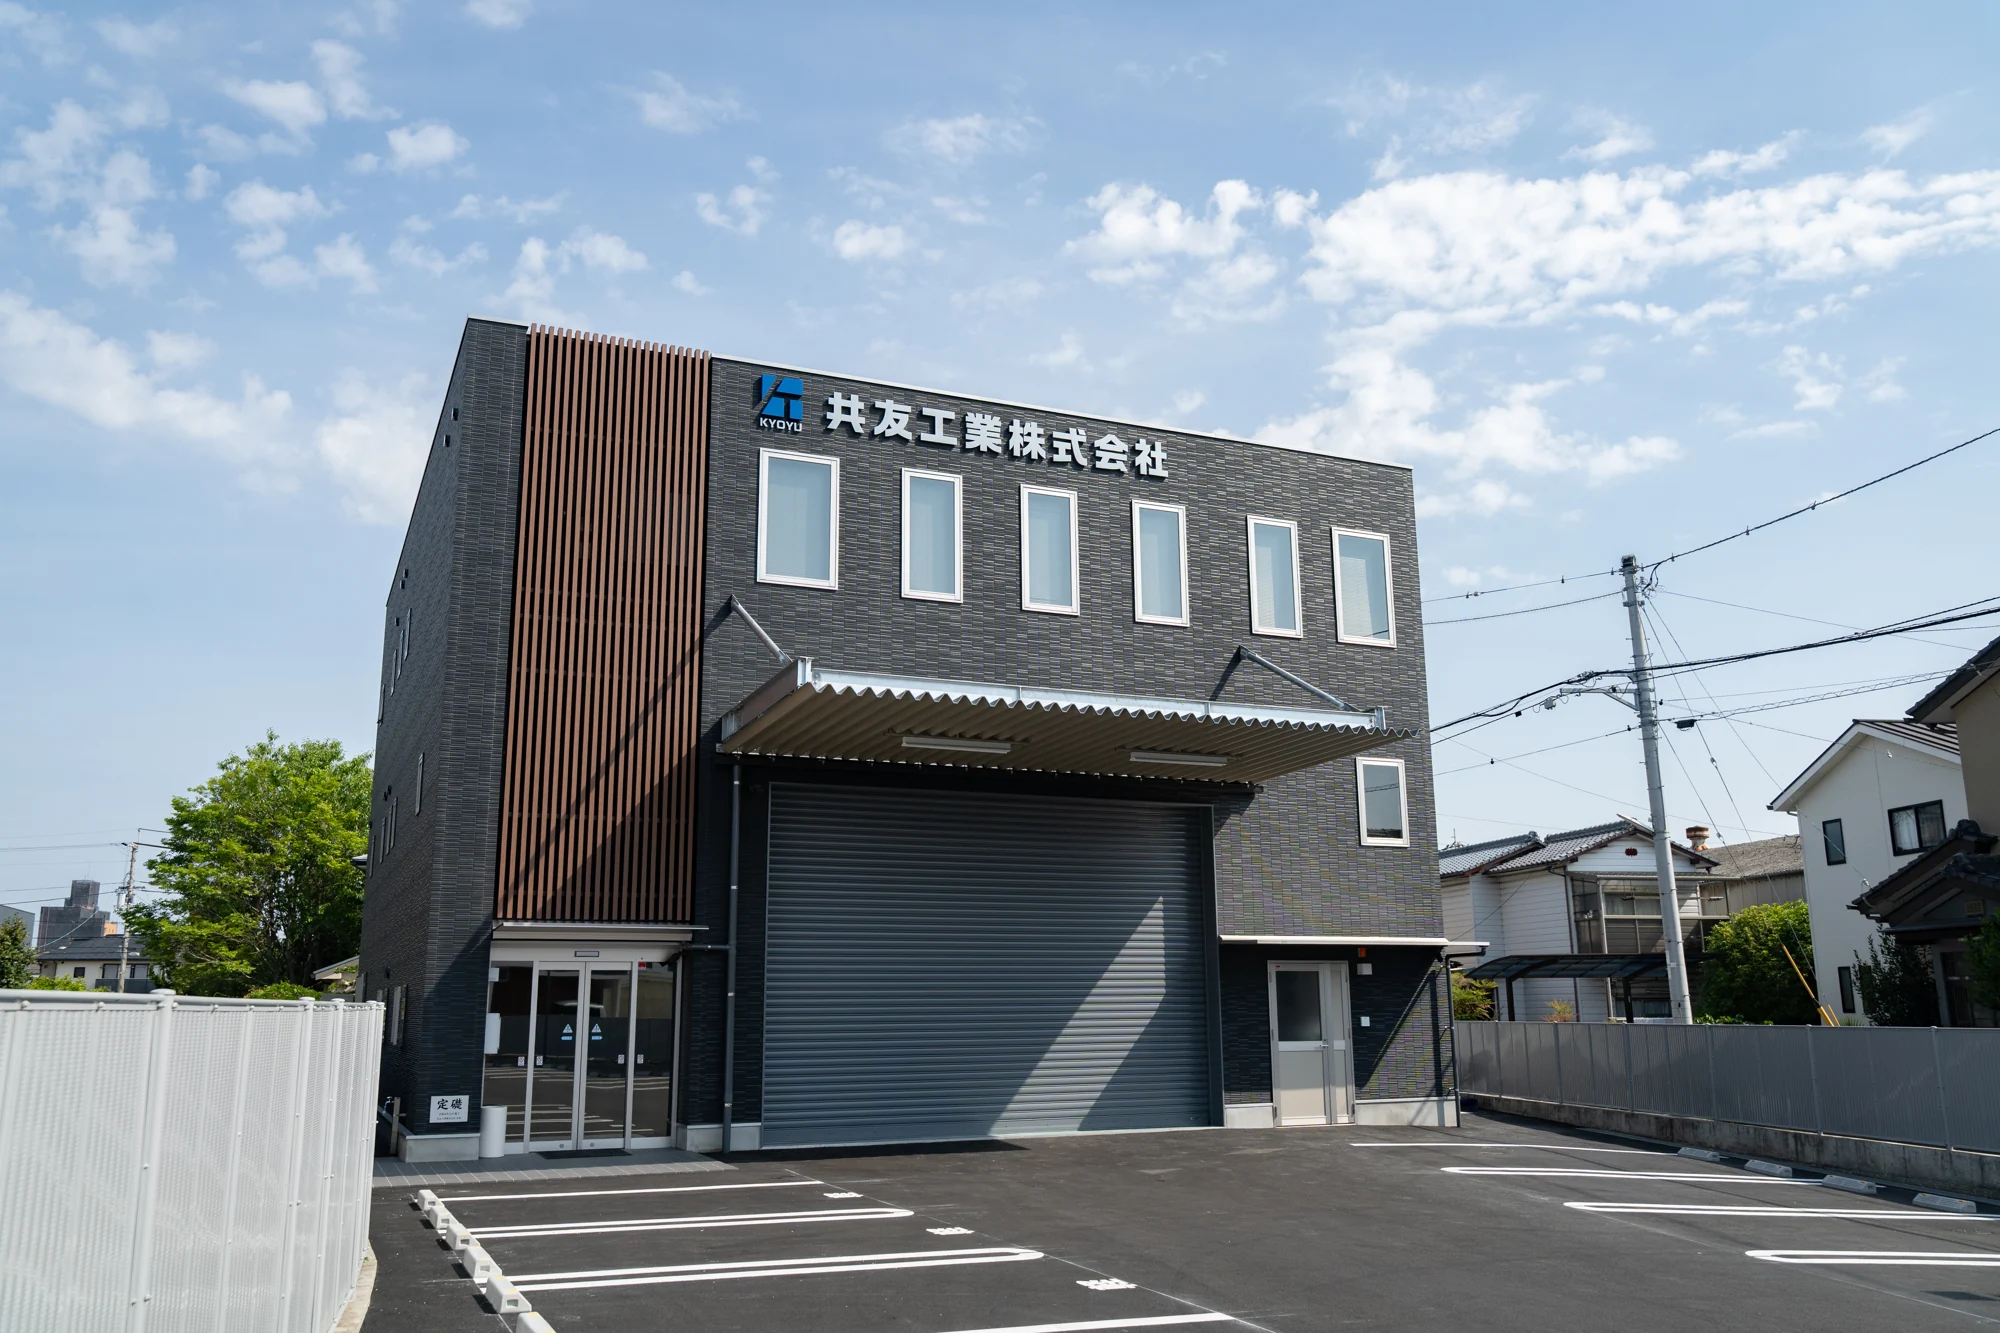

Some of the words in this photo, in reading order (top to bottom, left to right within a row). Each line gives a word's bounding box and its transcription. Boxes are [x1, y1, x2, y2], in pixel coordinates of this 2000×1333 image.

[759, 417, 803, 432] KYOYU
[826, 391, 1169, 478] 共友工業株式会社
[437, 1098, 463, 1110] 定礎
